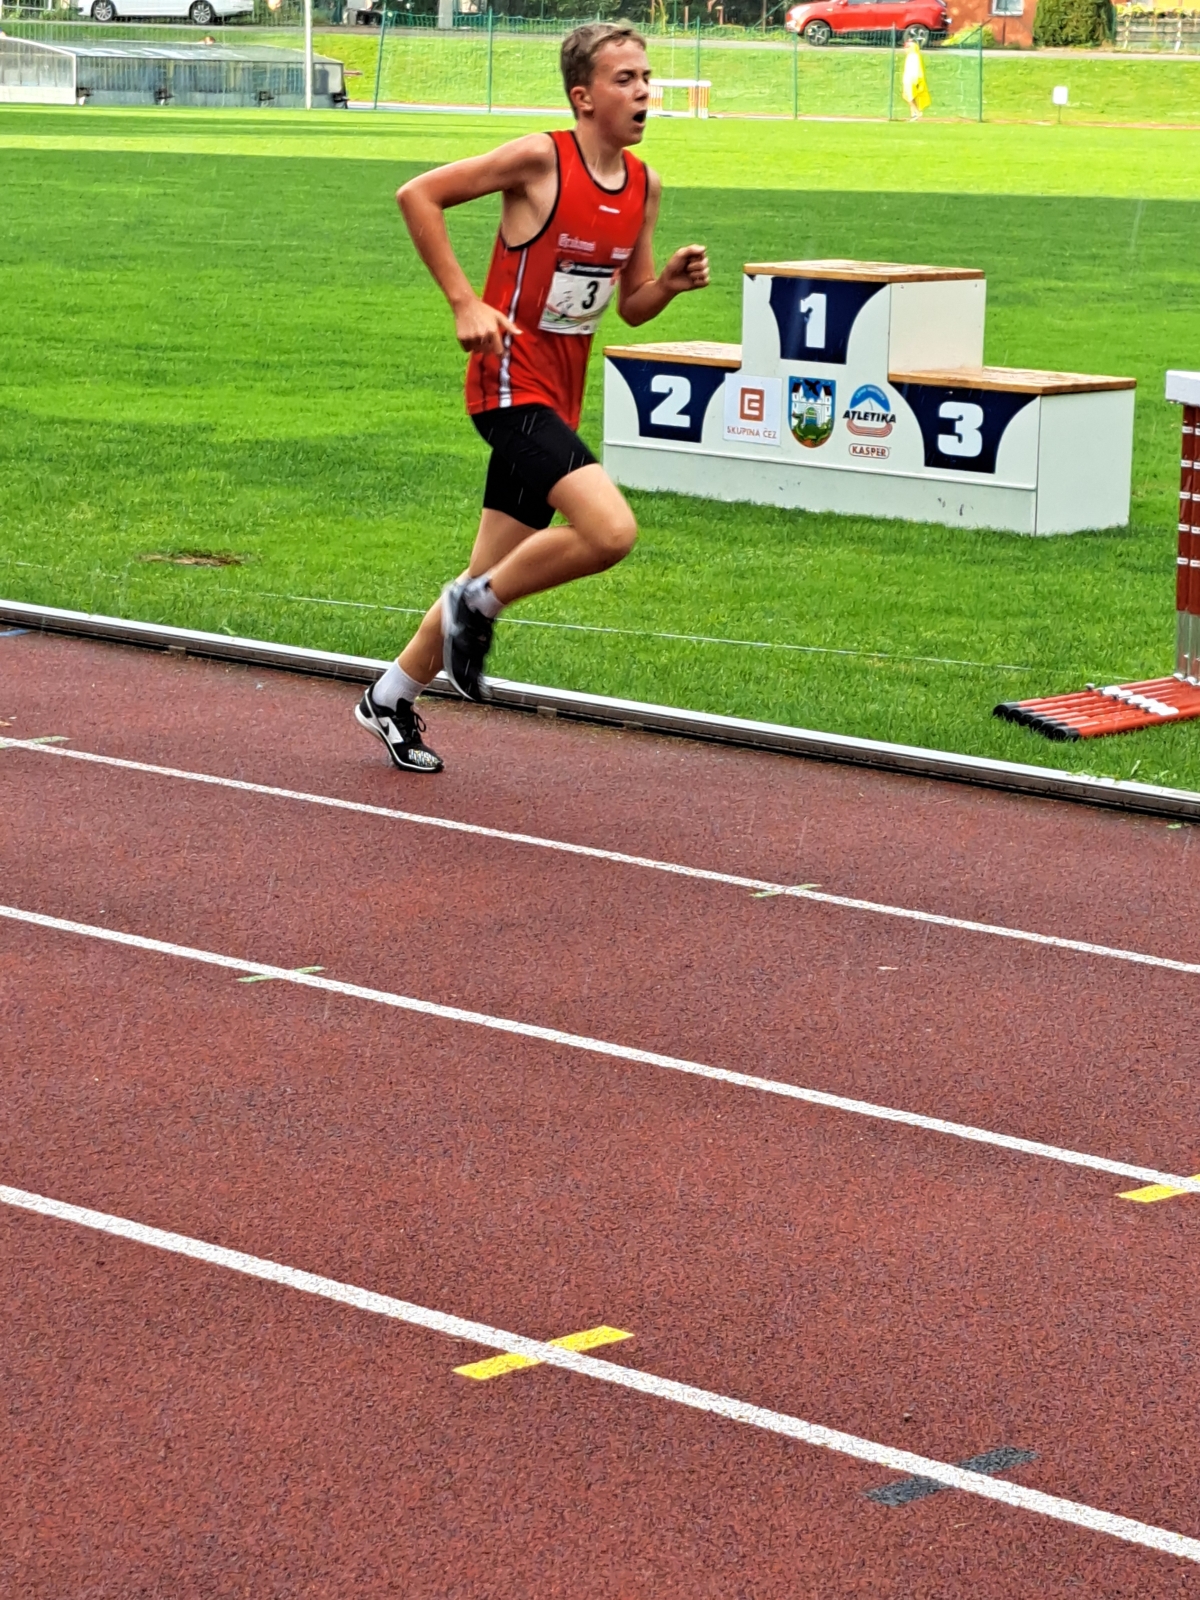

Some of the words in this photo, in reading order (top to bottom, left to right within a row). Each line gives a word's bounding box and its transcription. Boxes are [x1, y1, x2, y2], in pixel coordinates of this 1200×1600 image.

[582, 281, 599, 309] 3
[800, 293, 827, 349] 1
[650, 375, 691, 428] 2
[842, 410, 896, 424] ATLETIKA
[937, 401, 984, 458] 3
[727, 425, 760, 438] SKUPINA
[852, 446, 887, 457] KASPER
